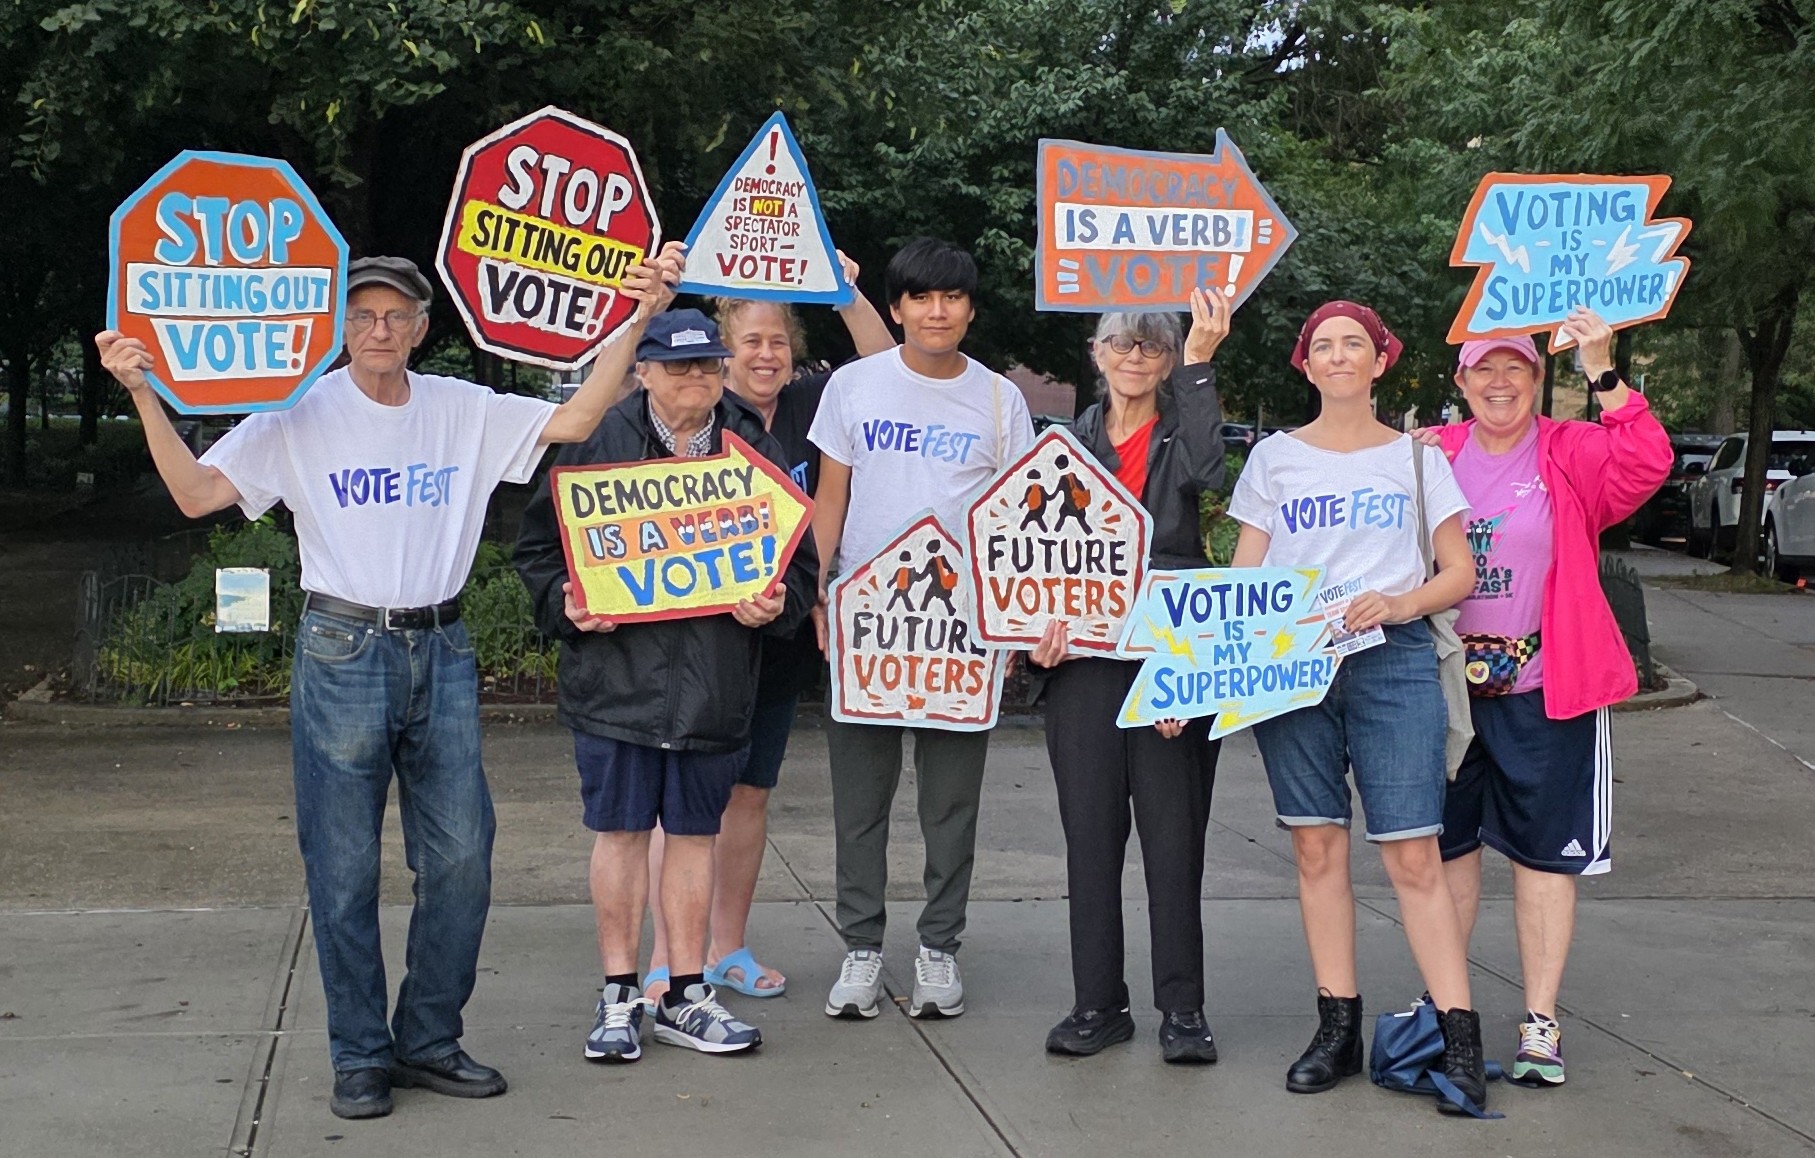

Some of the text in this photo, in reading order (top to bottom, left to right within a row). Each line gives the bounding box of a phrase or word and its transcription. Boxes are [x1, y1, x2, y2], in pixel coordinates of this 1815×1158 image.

[497, 144, 633, 233] STOP
[734, 176, 806, 198] DEMOCRACY
[1056, 158, 1241, 208] DEMOCRACY
[153, 190, 305, 266] STOP
[724, 215, 801, 237] SPECTATOR
[733, 197, 798, 218] IS NOT A
[1065, 208, 1247, 248] IS A VERB!
[1495, 190, 1636, 236] VOTING
[471, 209, 636, 280] SITTING OUT
[1561, 228, 1582, 251] IS
[716, 252, 808, 285] VOTE!
[1084, 253, 1245, 298] VOTE!
[1549, 252, 1590, 278] MY
[138, 270, 329, 314] SITTING OUT
[485, 262, 612, 336] VOTE!
[1485, 270, 1675, 321] SUPERPOWER!
[165, 321, 307, 373] VOTE!
[570, 464, 755, 519] DEMOCRACY
[585, 501, 771, 560] IS A VERB!
[616, 534, 777, 607] VOTE!
[987, 534, 1129, 577] FUTURE
[989, 575, 1127, 618] VOTERS
[1161, 580, 1294, 629] VOTING
[852, 612, 987, 657] FUTUR
[1213, 641, 1252, 666] MY
[1223, 620, 1245, 642] IS
[853, 654, 987, 697] VOTERS
[1150, 655, 1333, 710] SUPERPOWER!
